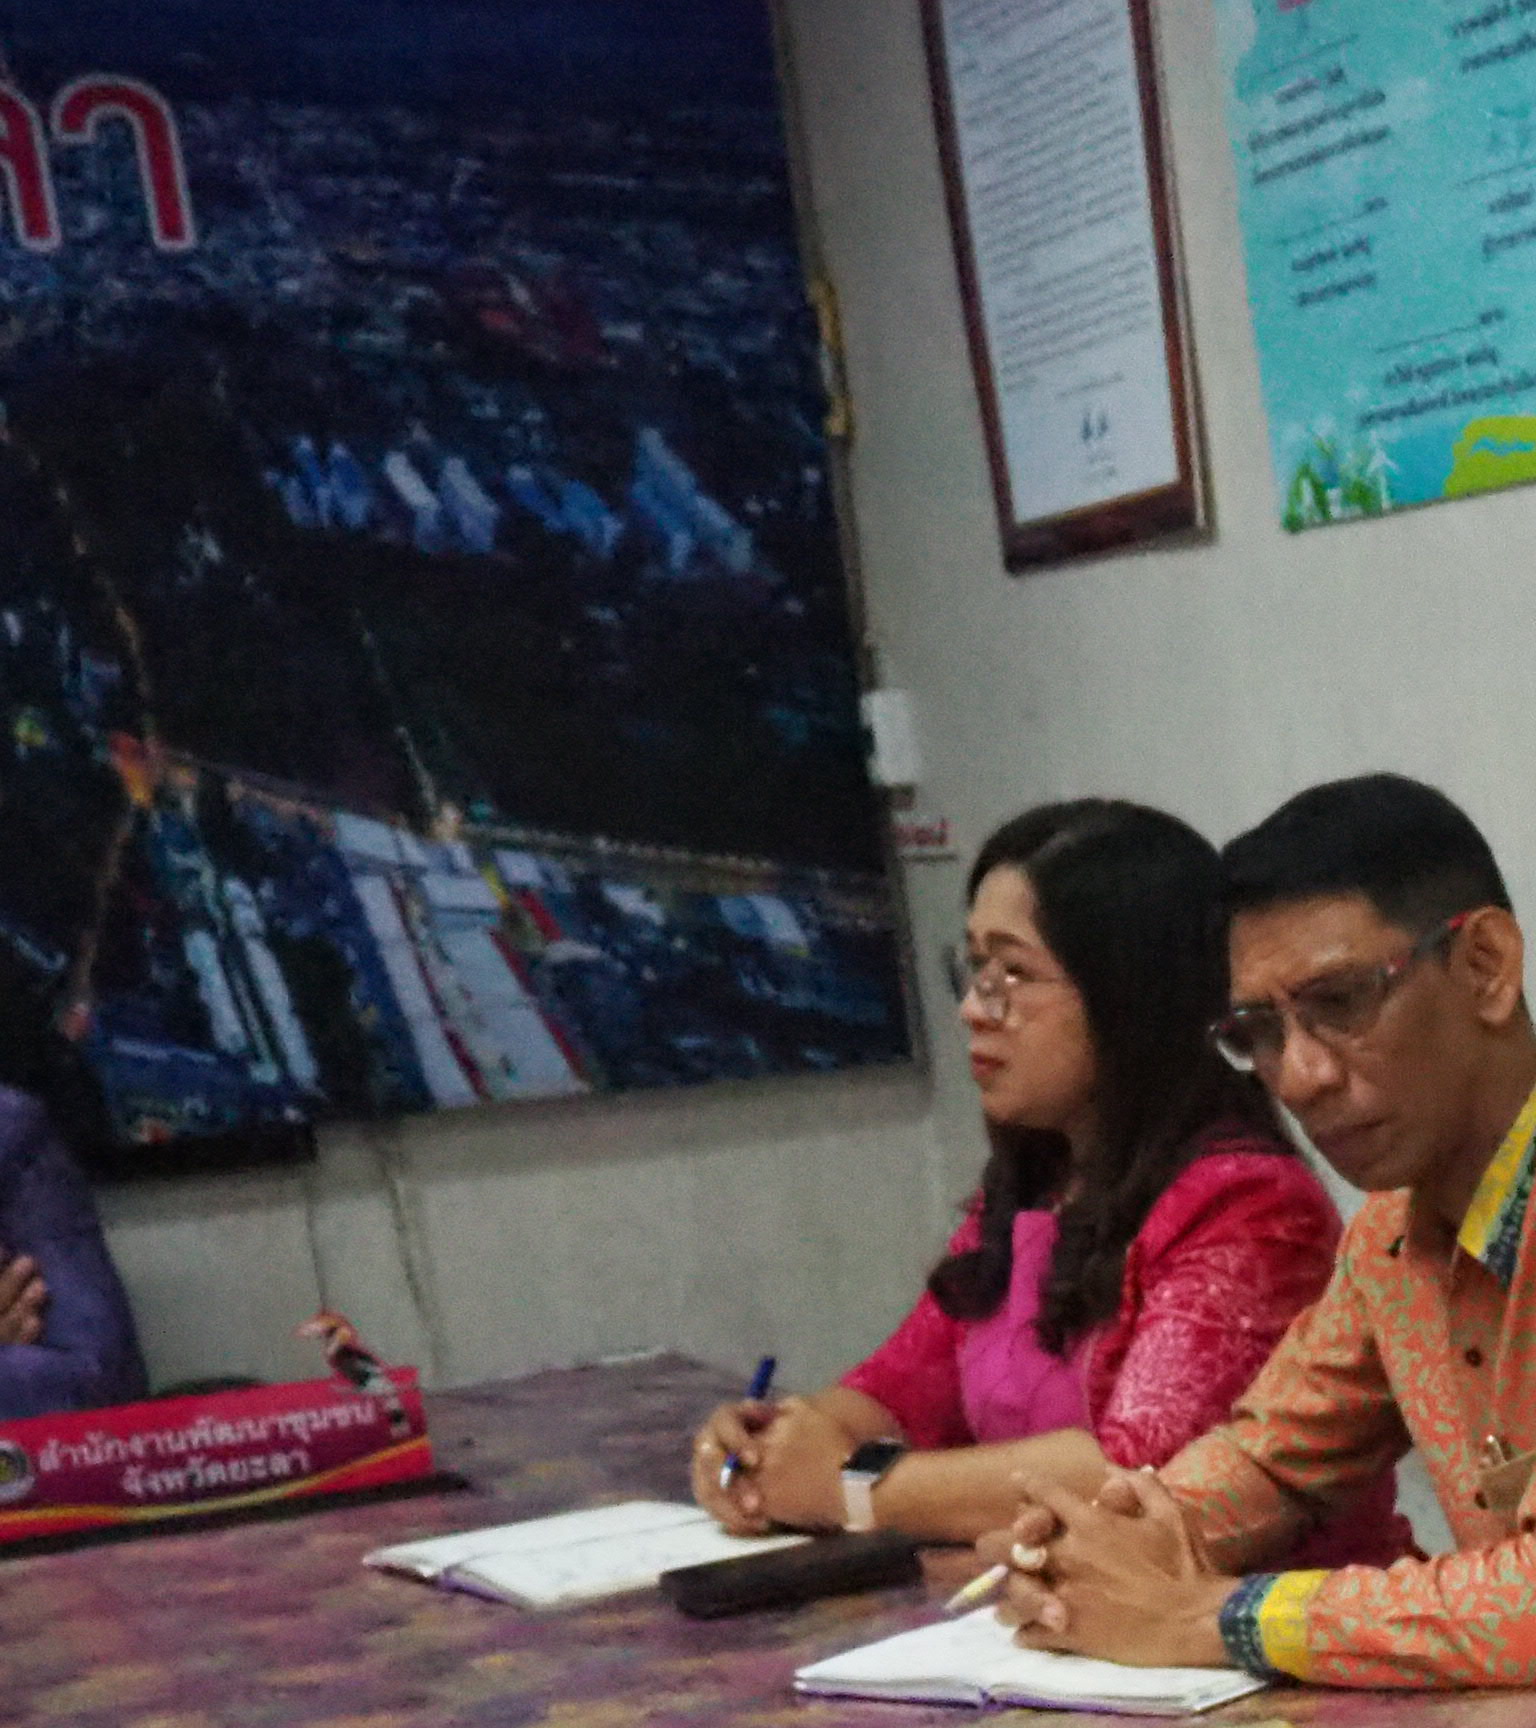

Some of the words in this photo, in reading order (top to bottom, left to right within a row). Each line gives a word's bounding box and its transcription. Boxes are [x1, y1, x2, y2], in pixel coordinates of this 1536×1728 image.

[39, 1402, 376, 1472] สำนักงานพัฒนาชุมชน
[121, 1449, 311, 1497] จังหวัดยะลา
